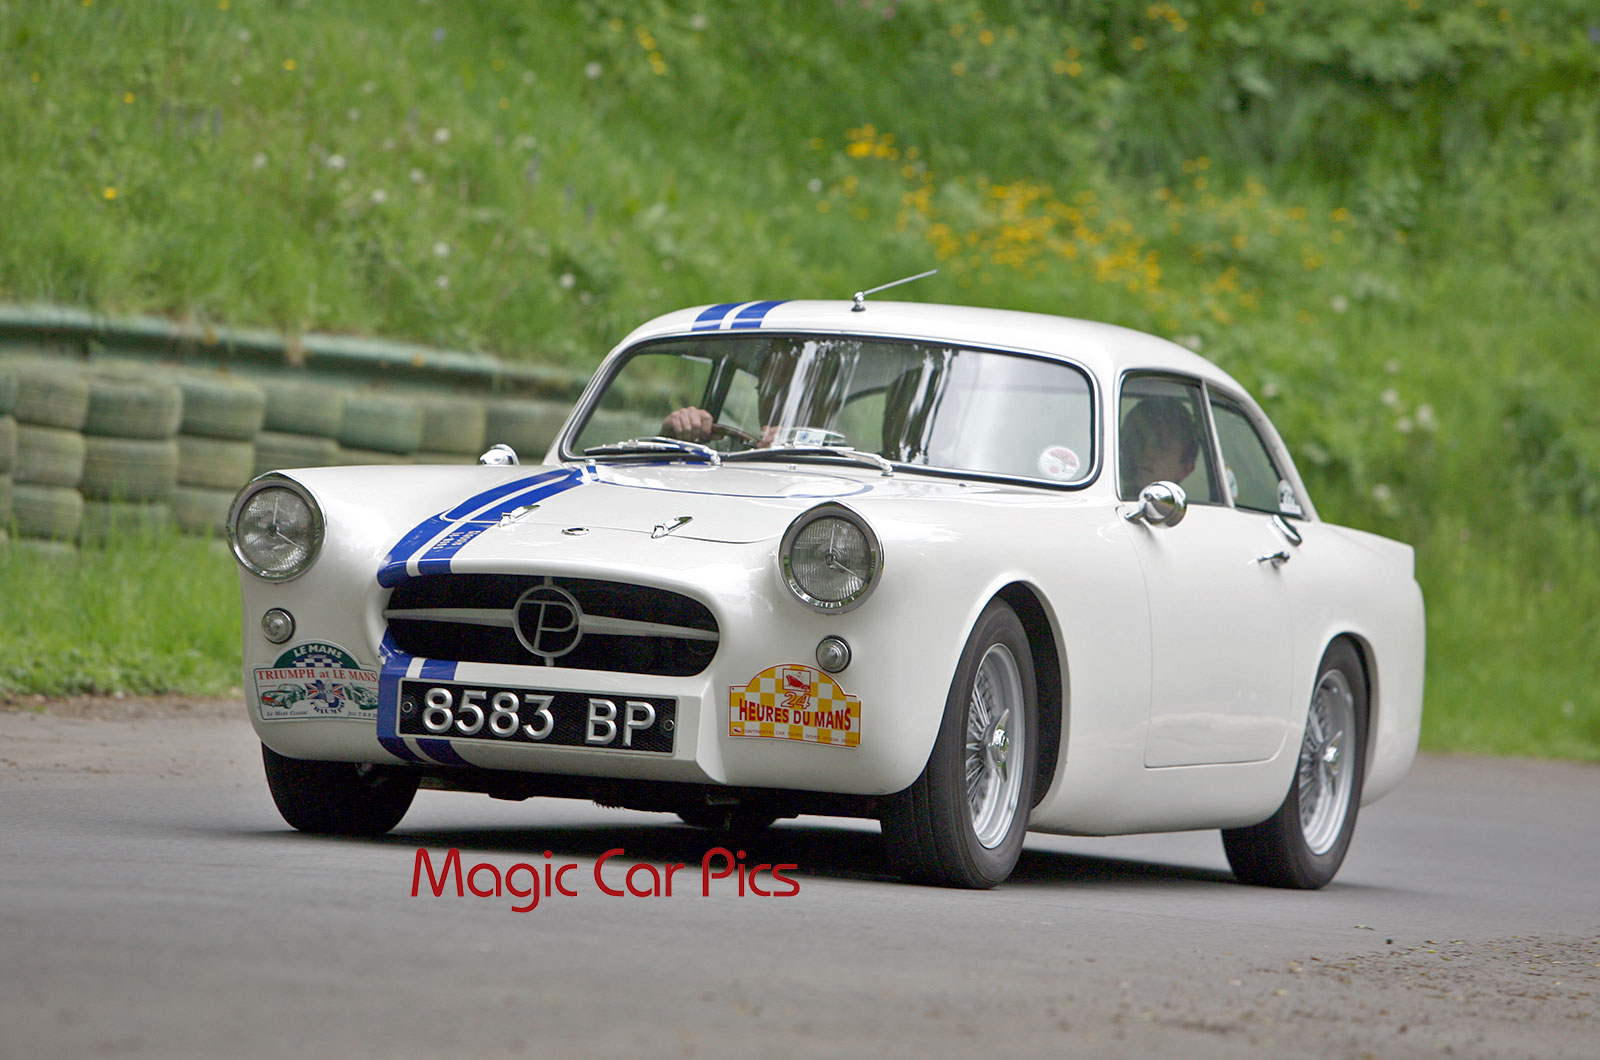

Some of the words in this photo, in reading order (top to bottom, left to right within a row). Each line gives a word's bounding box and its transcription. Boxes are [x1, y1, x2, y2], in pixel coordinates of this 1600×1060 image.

[293, 645, 307, 657] LE
[308, 644, 343, 659] MANS
[256, 669, 315, 680] TRIUMPH
[319, 670, 330, 679] at
[333, 670, 346, 679] LE
[348, 671, 378, 683] MANS
[781, 691, 812, 710] 24
[422, 687, 554, 740] 8583
[585, 698, 656, 746] BP
[739, 698, 789, 723] HEURES
[793, 710, 811, 726] DU
[814, 708, 851, 731] MANS
